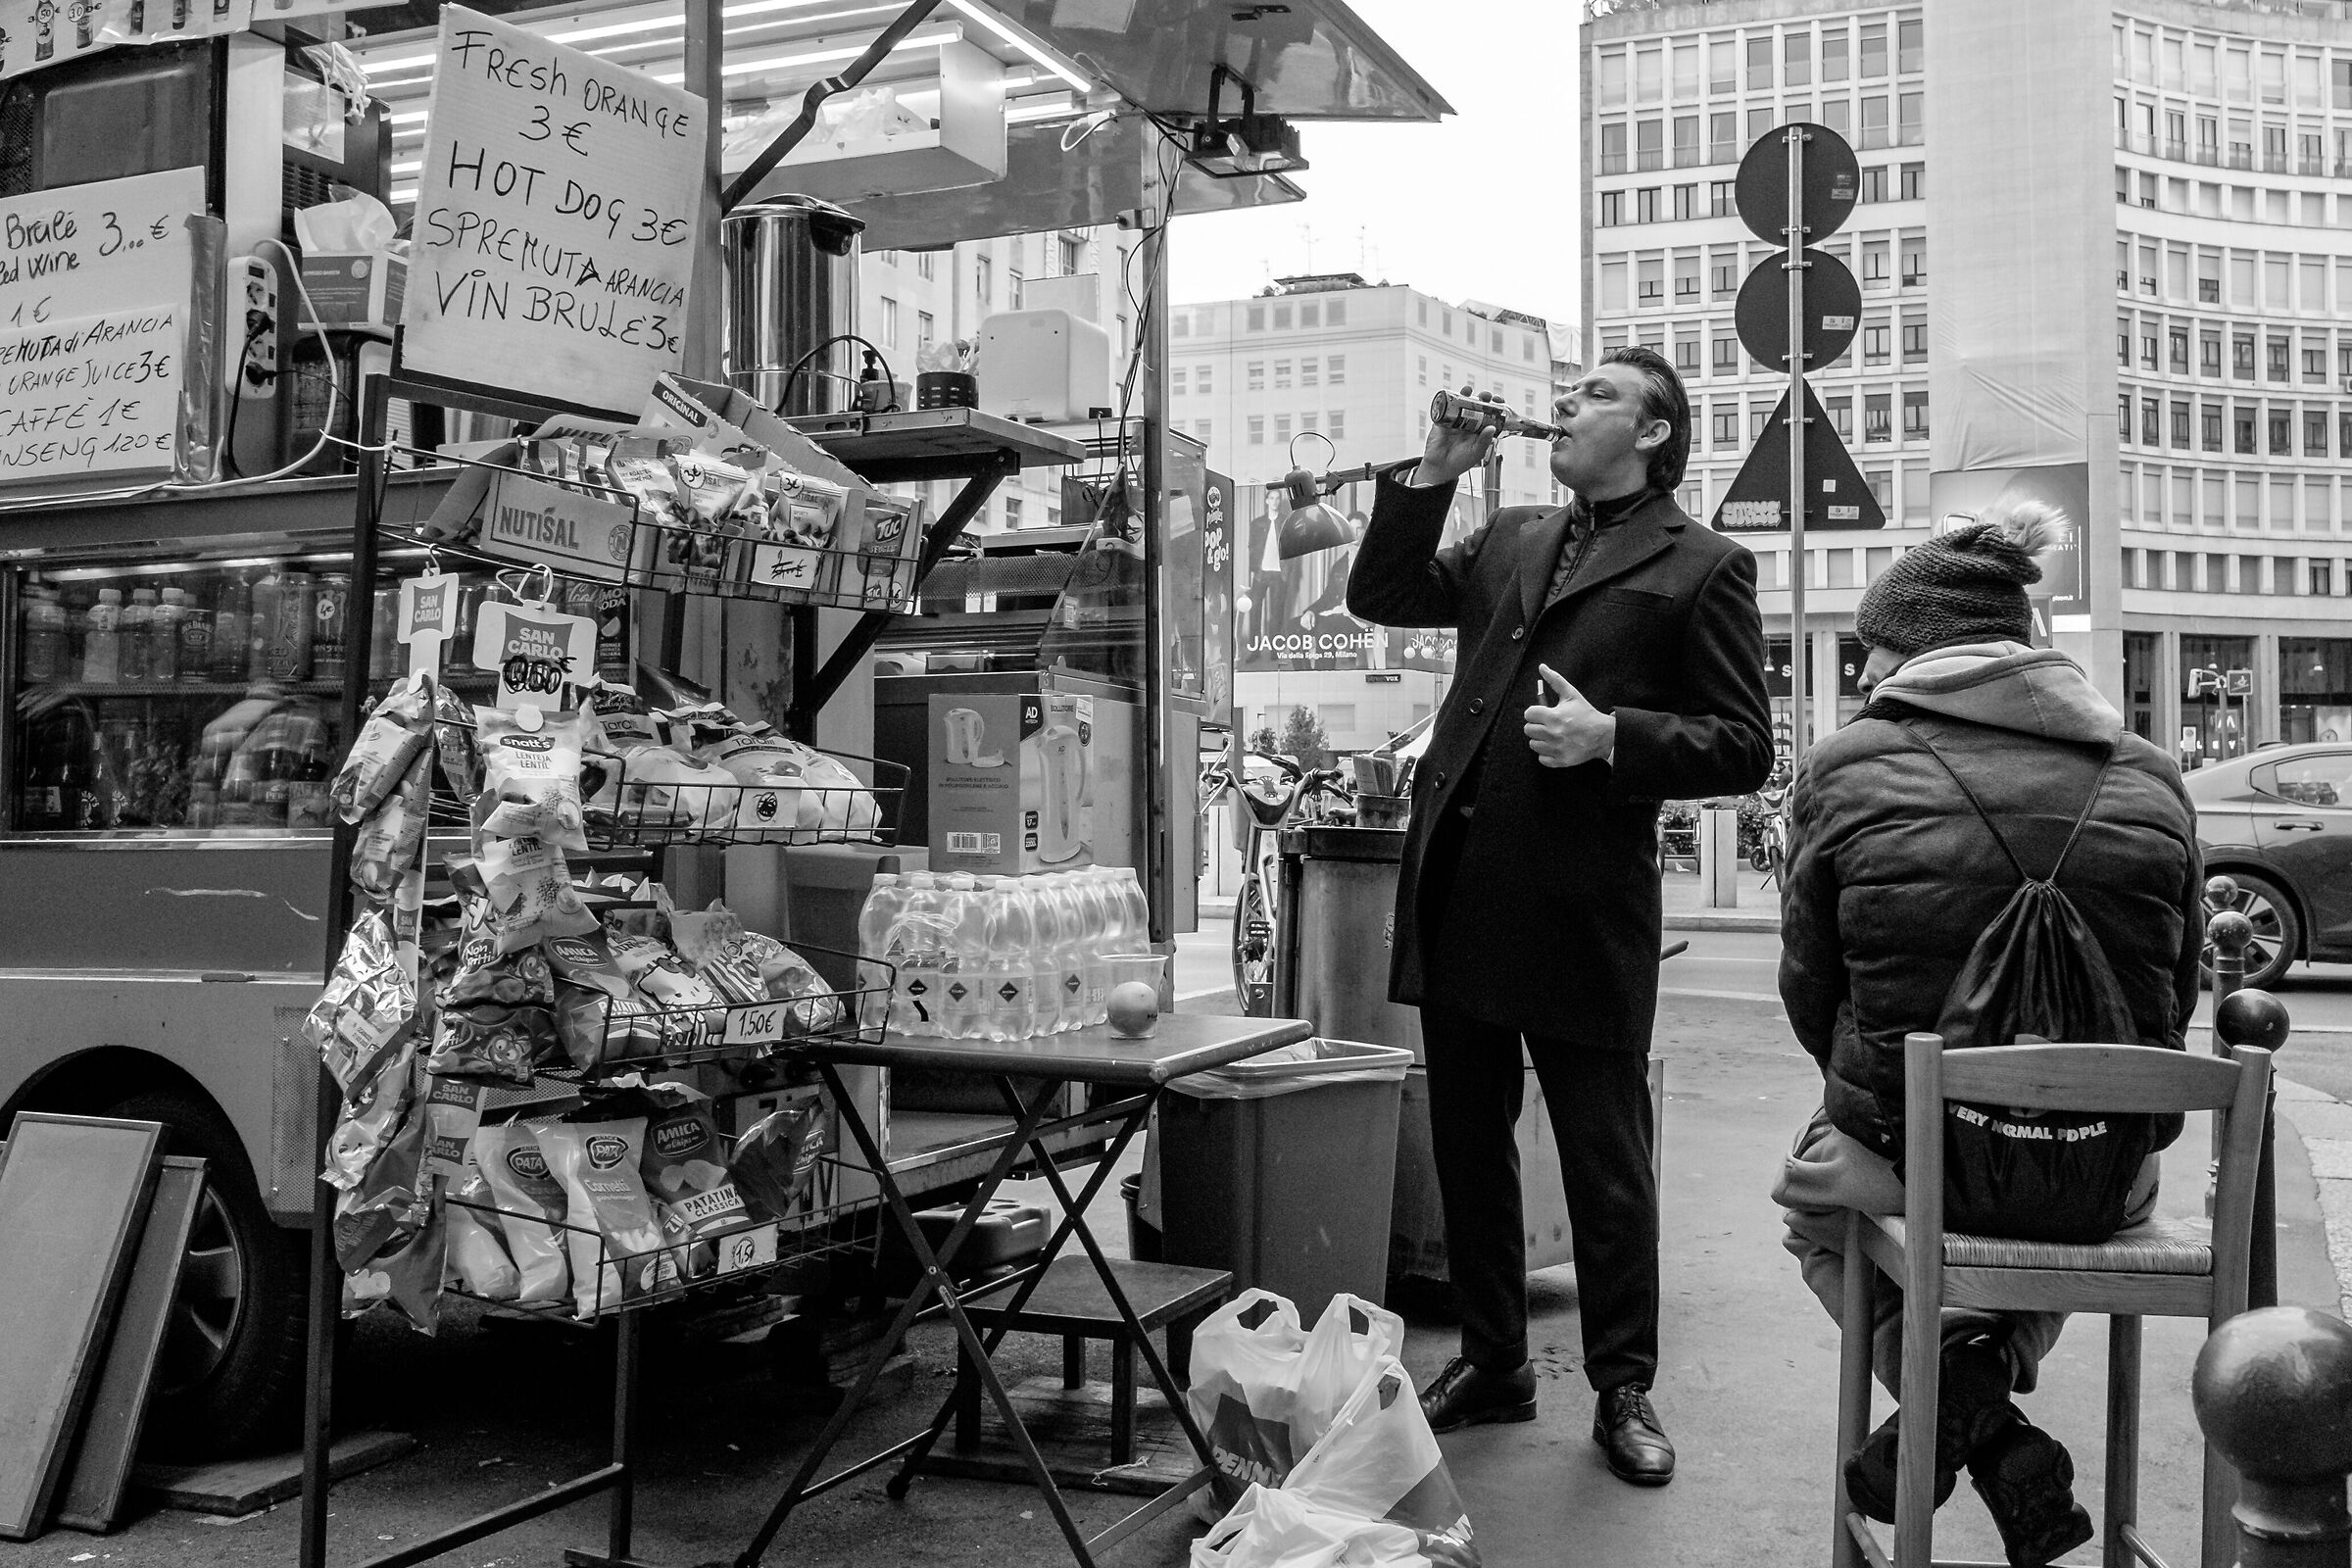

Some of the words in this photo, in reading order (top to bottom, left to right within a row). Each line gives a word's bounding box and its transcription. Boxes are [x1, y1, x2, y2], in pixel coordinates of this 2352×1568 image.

[584, 78, 689, 139] ORANGE
[449, 140, 546, 206] HOT
[555, 179, 625, 240] DOG
[27, 251, 80, 280] Wine
[426, 208, 603, 288] SPREMUTA
[605, 268, 685, 308] ARANCIA
[82, 314, 173, 348] ARANCIA
[8, 367, 79, 396] ORANGE
[81, 359, 136, 389] JUICE
[661, 390, 701, 425] ORIGINAL
[877, 515, 902, 540] TUC
[419, 594, 439, 609] SAN
[414, 607, 441, 623] CARLO
[518, 627, 556, 646] SAN
[1247, 634, 1315, 652] JACOB
[1318, 627, 1389, 650] COHËN
[508, 639, 564, 660] CARLO
[1843, 662, 1856, 676] S
[1025, 706, 1038, 719] AD
[503, 736, 551, 750] snatt's
[519, 760, 550, 770] LENTIL
[555, 945, 599, 957] AMICA
[738, 1009, 778, 1040] 1,50€
[432, 1090, 475, 1104] CARLO
[441, 1084, 469, 1096] SAN
[1947, 1102, 1989, 1127] VERY
[656, 1120, 702, 1144] AMICA
[514, 1155, 543, 1171] PATA
[584, 1178, 632, 1193] Cornetti
[694, 1198, 741, 1218] CLASSICA
